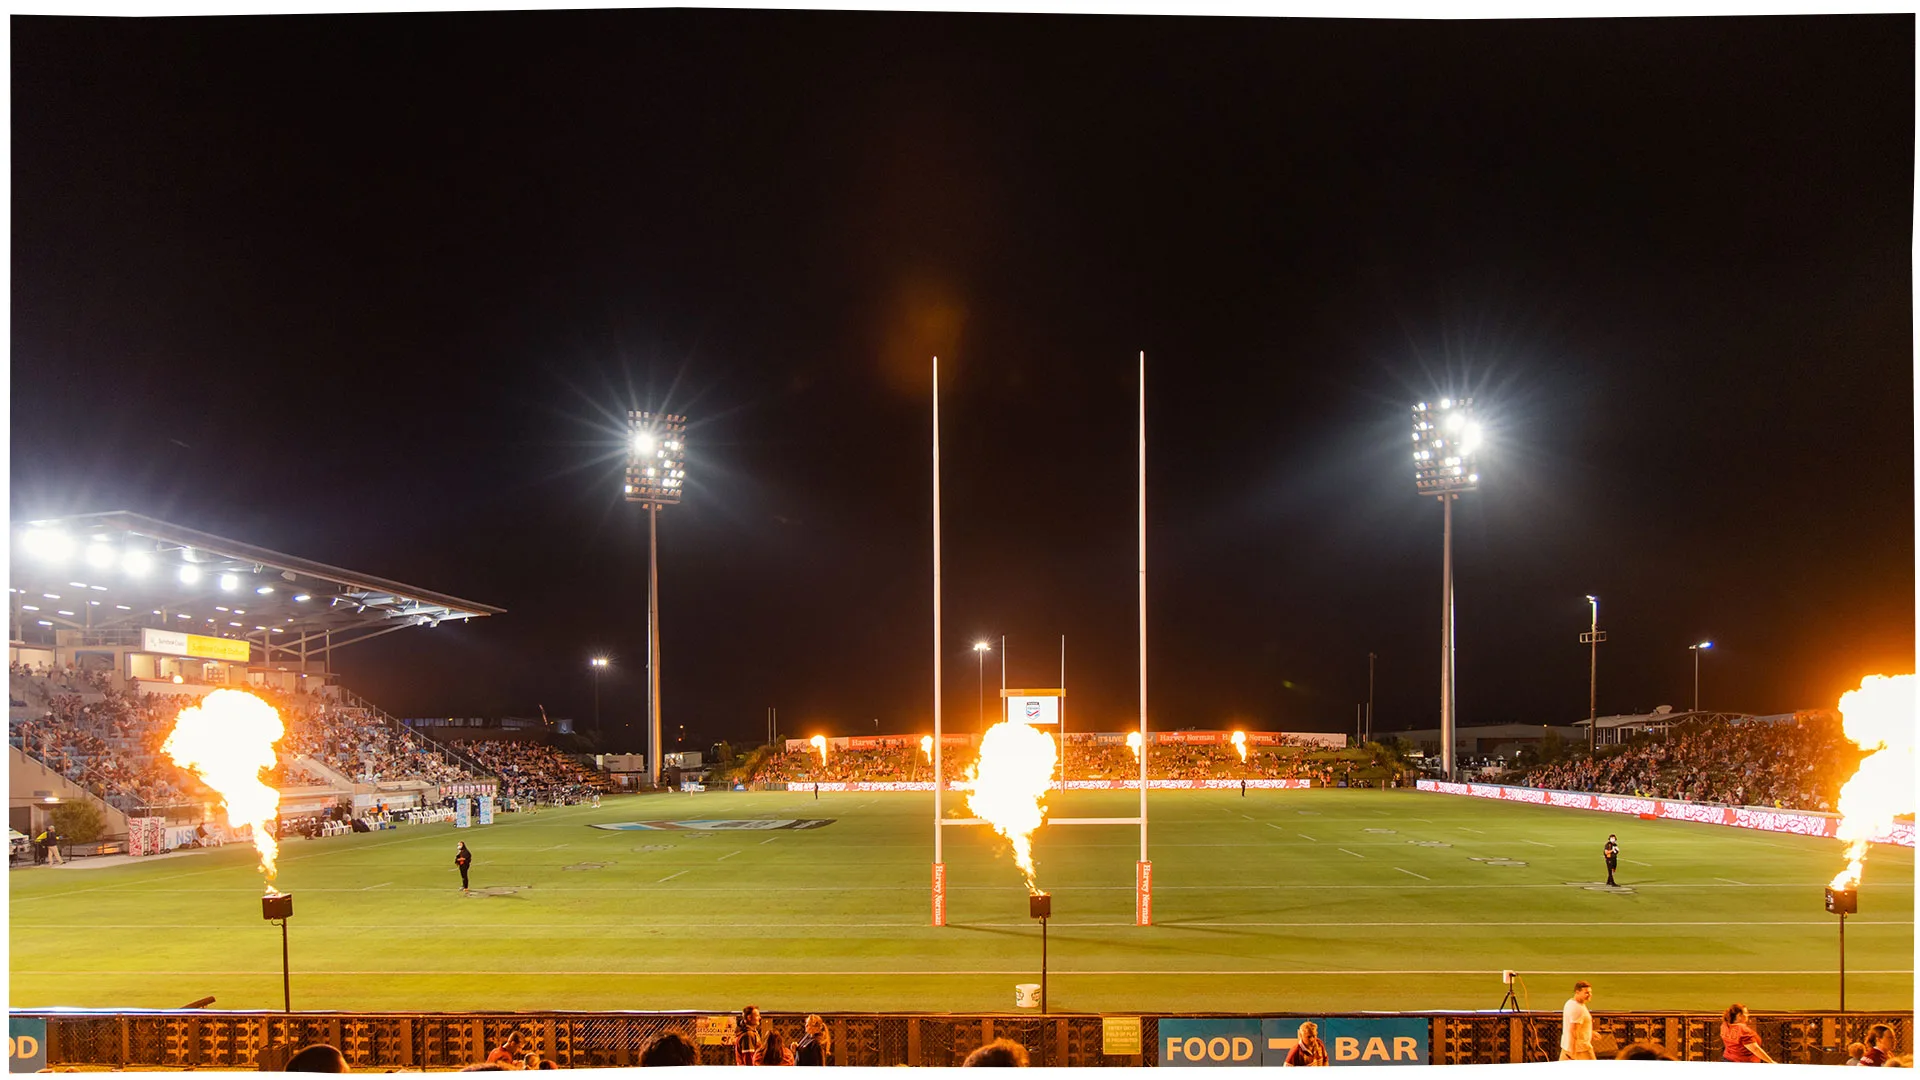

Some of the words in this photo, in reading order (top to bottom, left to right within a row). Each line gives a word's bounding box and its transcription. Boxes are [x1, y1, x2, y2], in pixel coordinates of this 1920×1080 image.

[1249, 734, 1277, 742] Norma
[934, 866, 943, 893] Harvey
[1141, 865, 1150, 892] Harvey
[1142, 894, 1150, 924] Norman
[9, 1036, 38, 1059] D
[1166, 1037, 1254, 1061] FOOD
[1335, 1036, 1419, 1061] BAR
